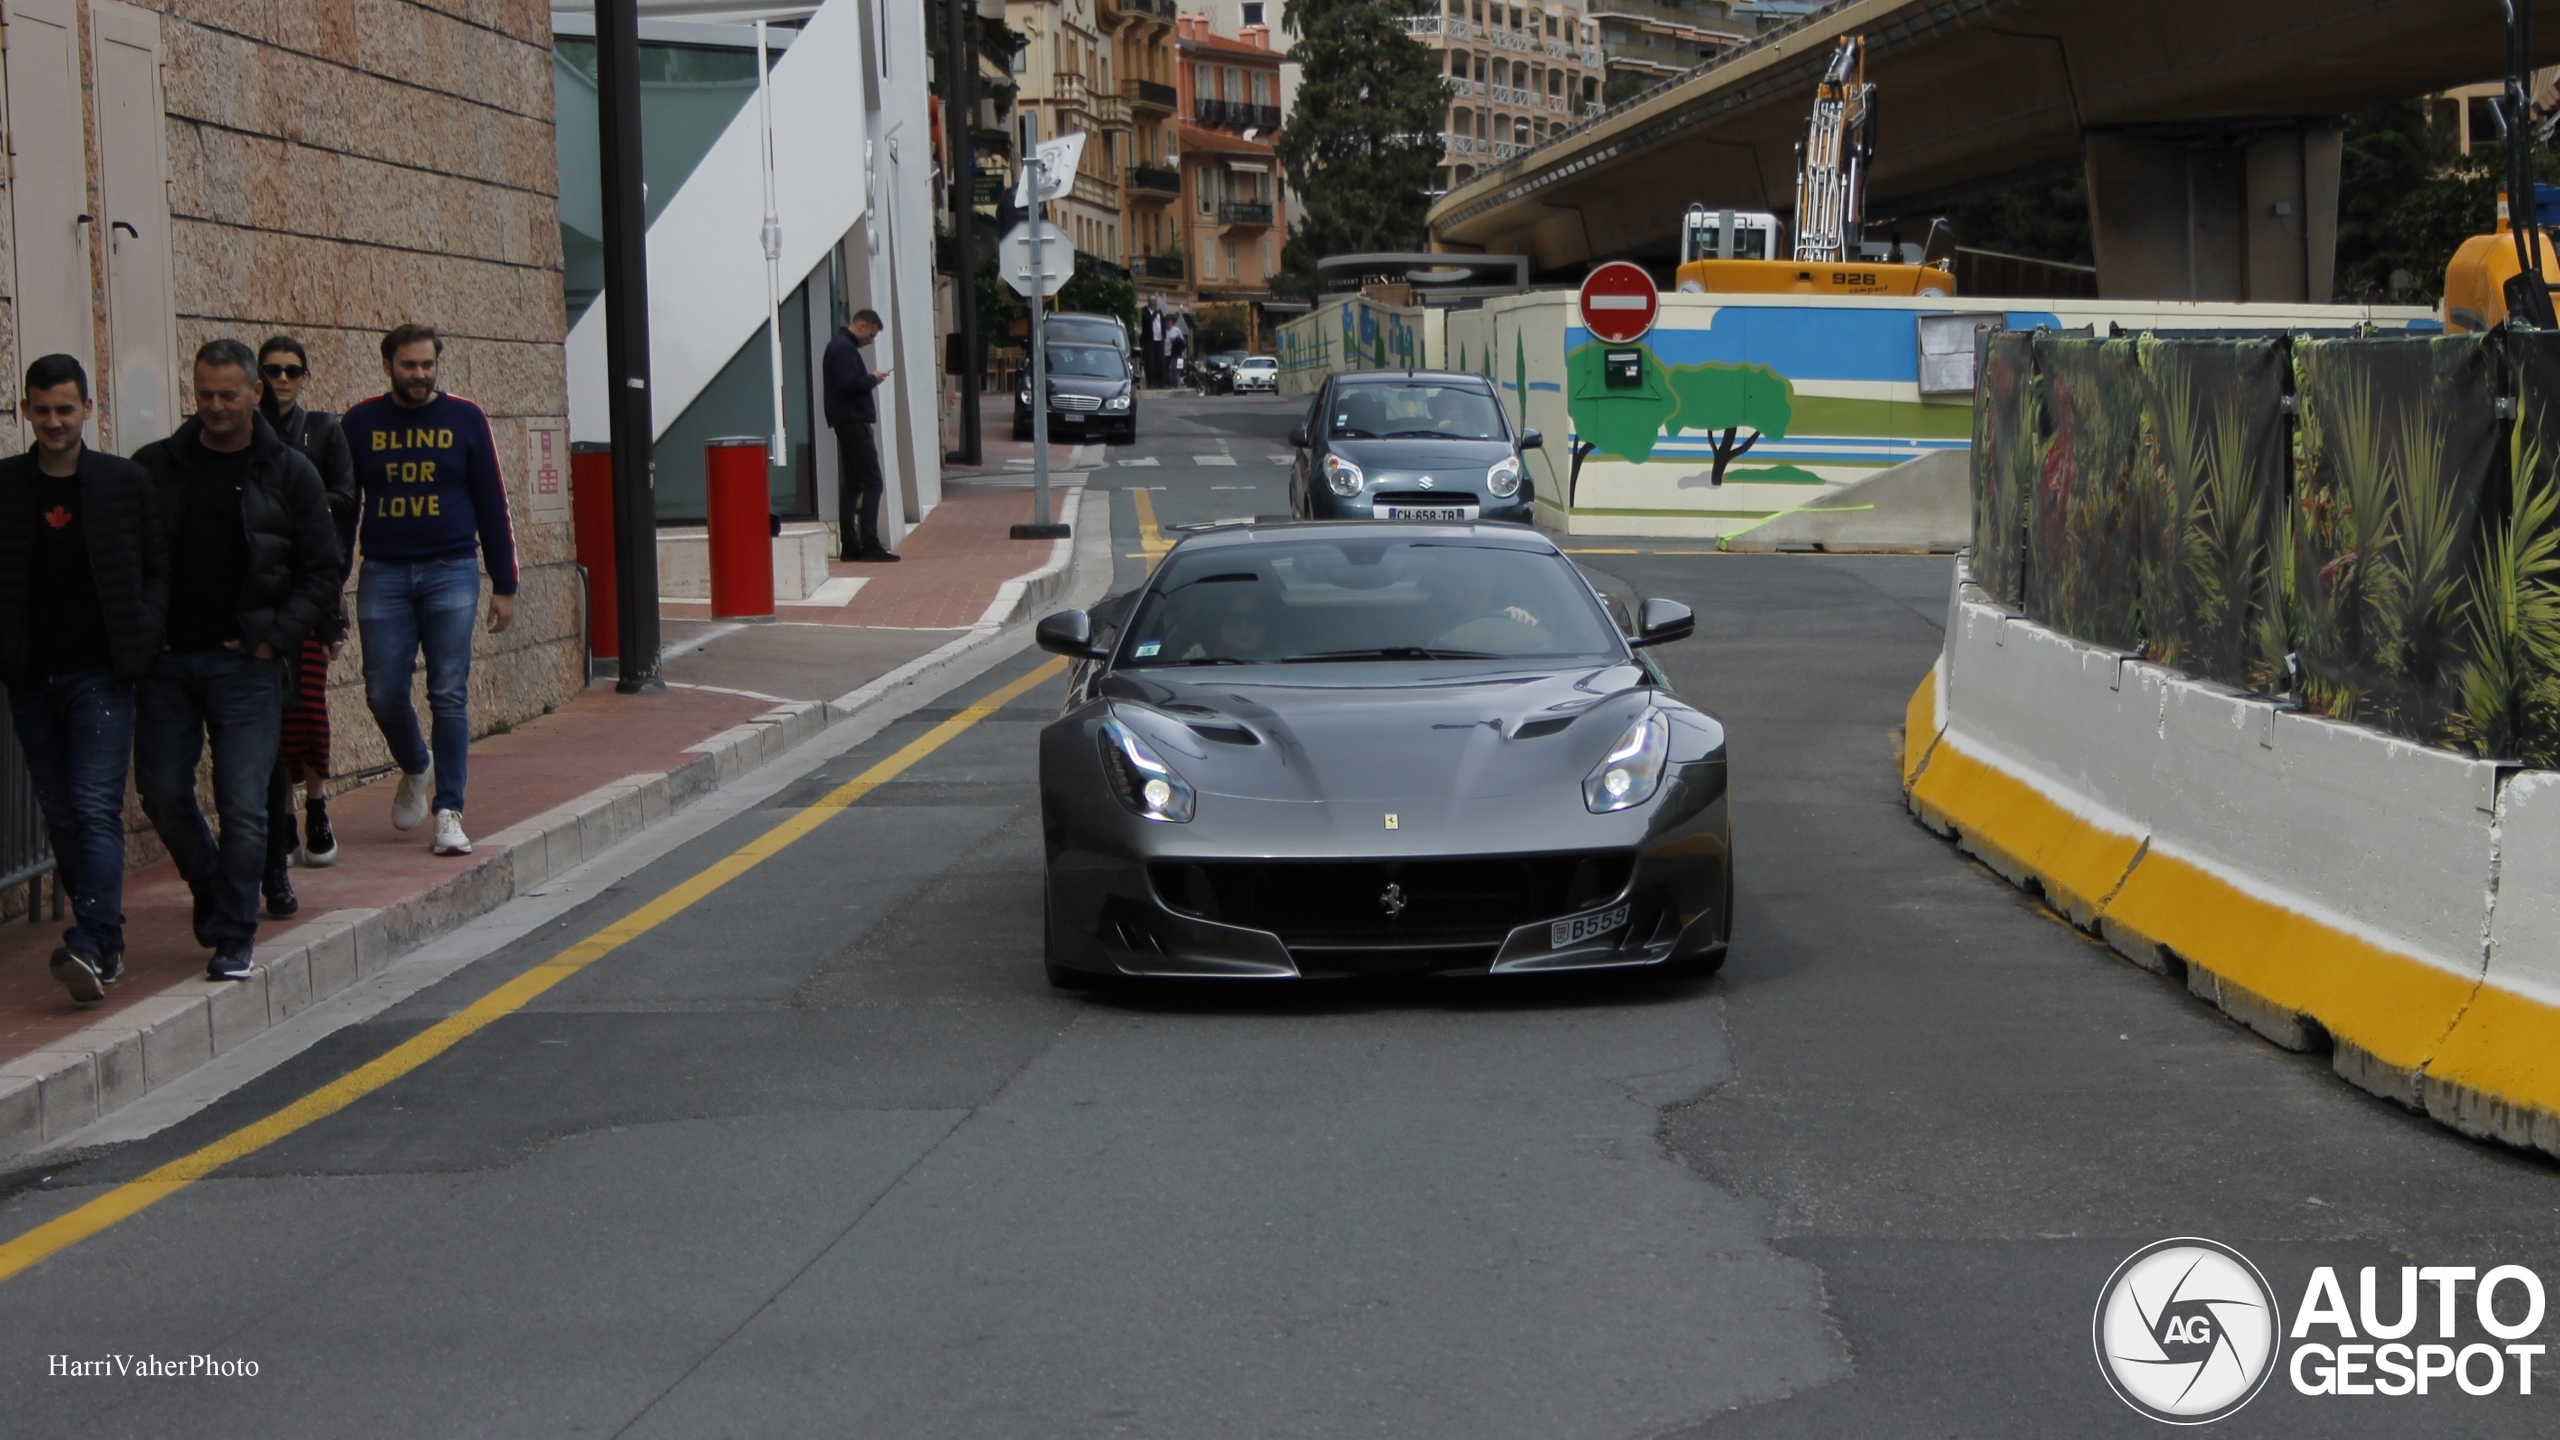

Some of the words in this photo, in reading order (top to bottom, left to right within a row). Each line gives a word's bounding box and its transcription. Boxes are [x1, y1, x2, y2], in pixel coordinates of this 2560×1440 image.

[973, 195, 991, 203] BAR
[1832, 273, 1876, 286] 926
[1849, 284, 1889, 294] compact
[372, 429, 454, 451] BLIND
[386, 461, 436, 483] FOR
[378, 495, 440, 518] LOVE
[1571, 907, 1628, 940] B559
